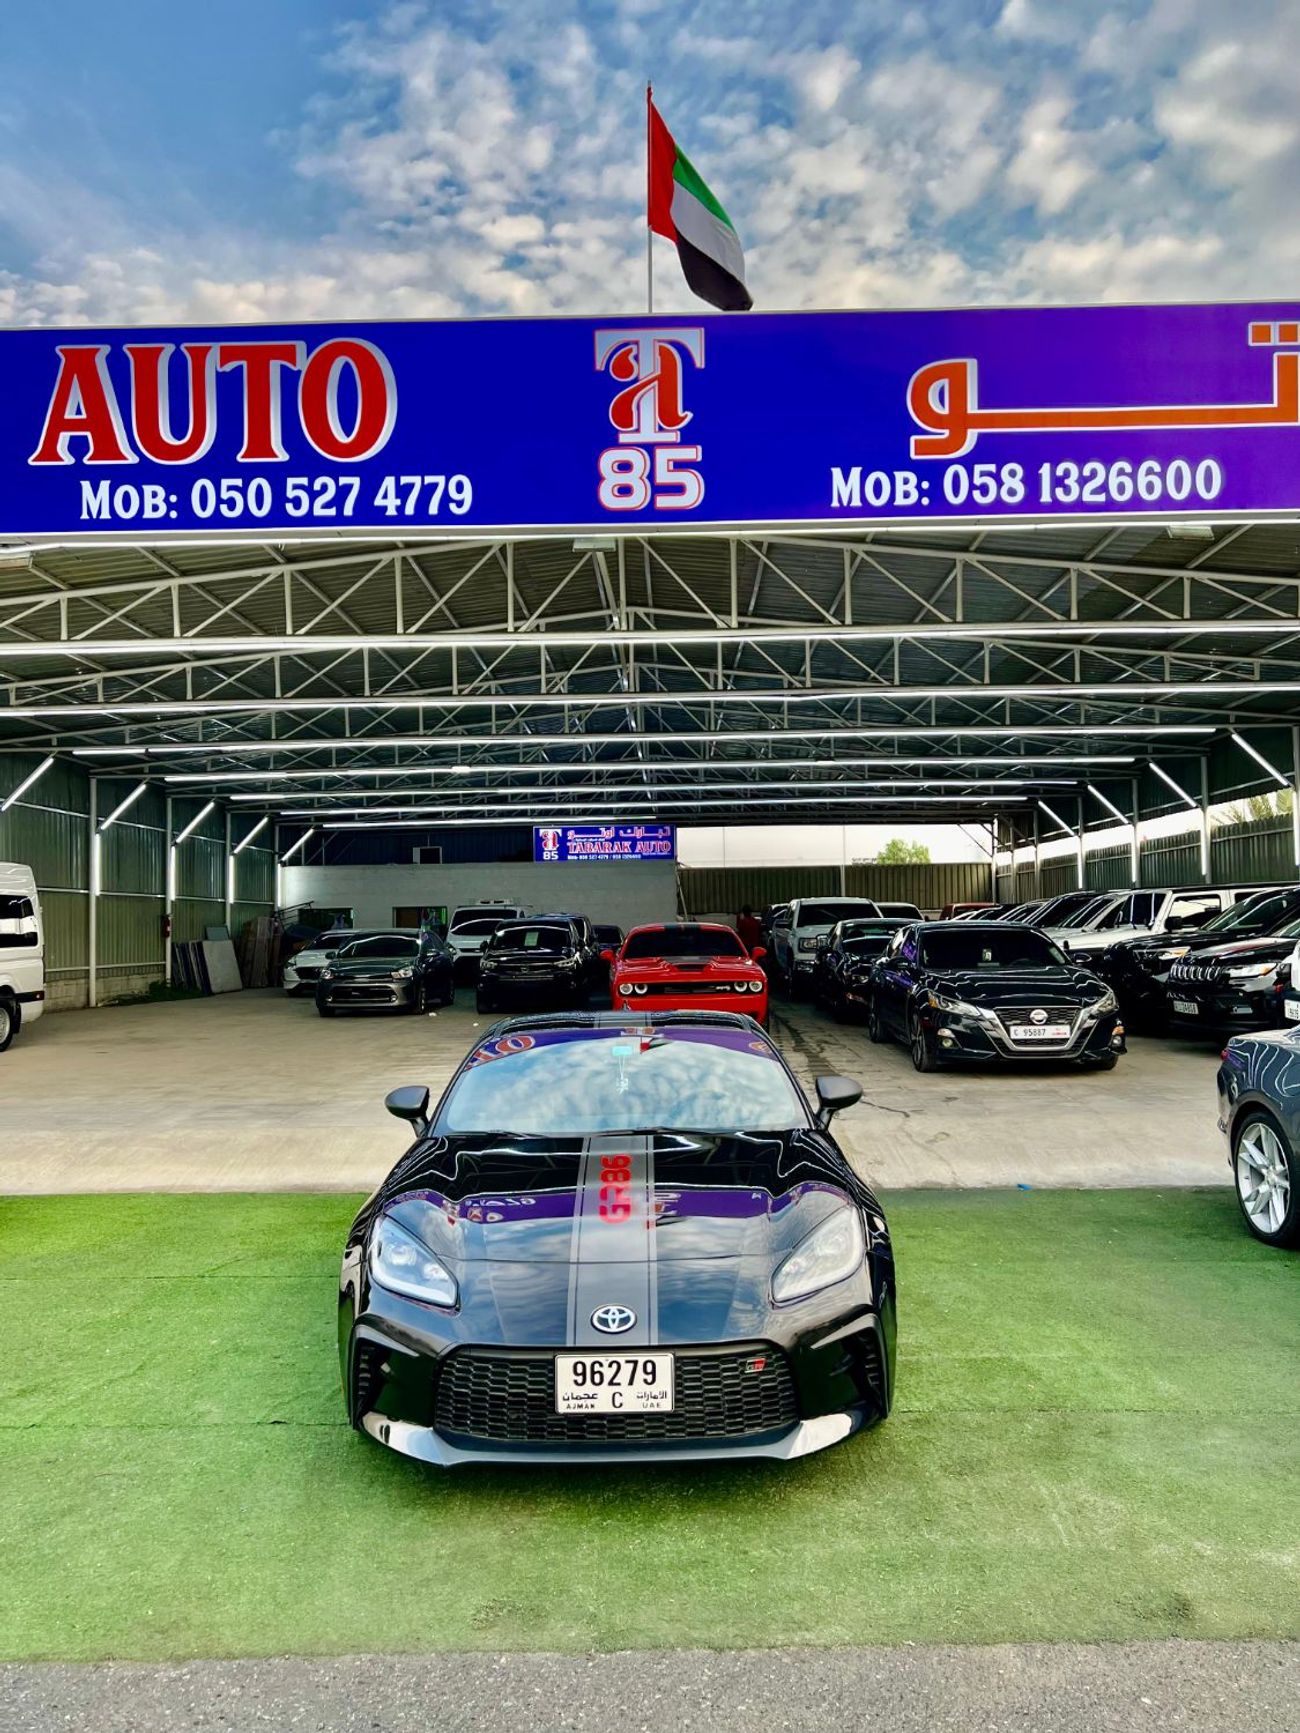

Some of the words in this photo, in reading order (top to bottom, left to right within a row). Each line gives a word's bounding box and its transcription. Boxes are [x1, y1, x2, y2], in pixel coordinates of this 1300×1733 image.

[27, 338, 398, 466] AUTO
[191, 478, 272, 518] 050
[285, 477, 361, 516] 527
[374, 475, 473, 515] 4779
[598, 445, 705, 511] 85
[943, 464, 1025, 505] 058
[1038, 459, 1222, 503] 1326600
[543, 851, 559, 860] 85
[567, 841, 632, 853] TABARAK
[634, 840, 671, 853] AUTO
[599, 1153, 631, 1224] GR86
[573, 1359, 657, 1387] 96279
[612, 1392, 623, 1408] C
